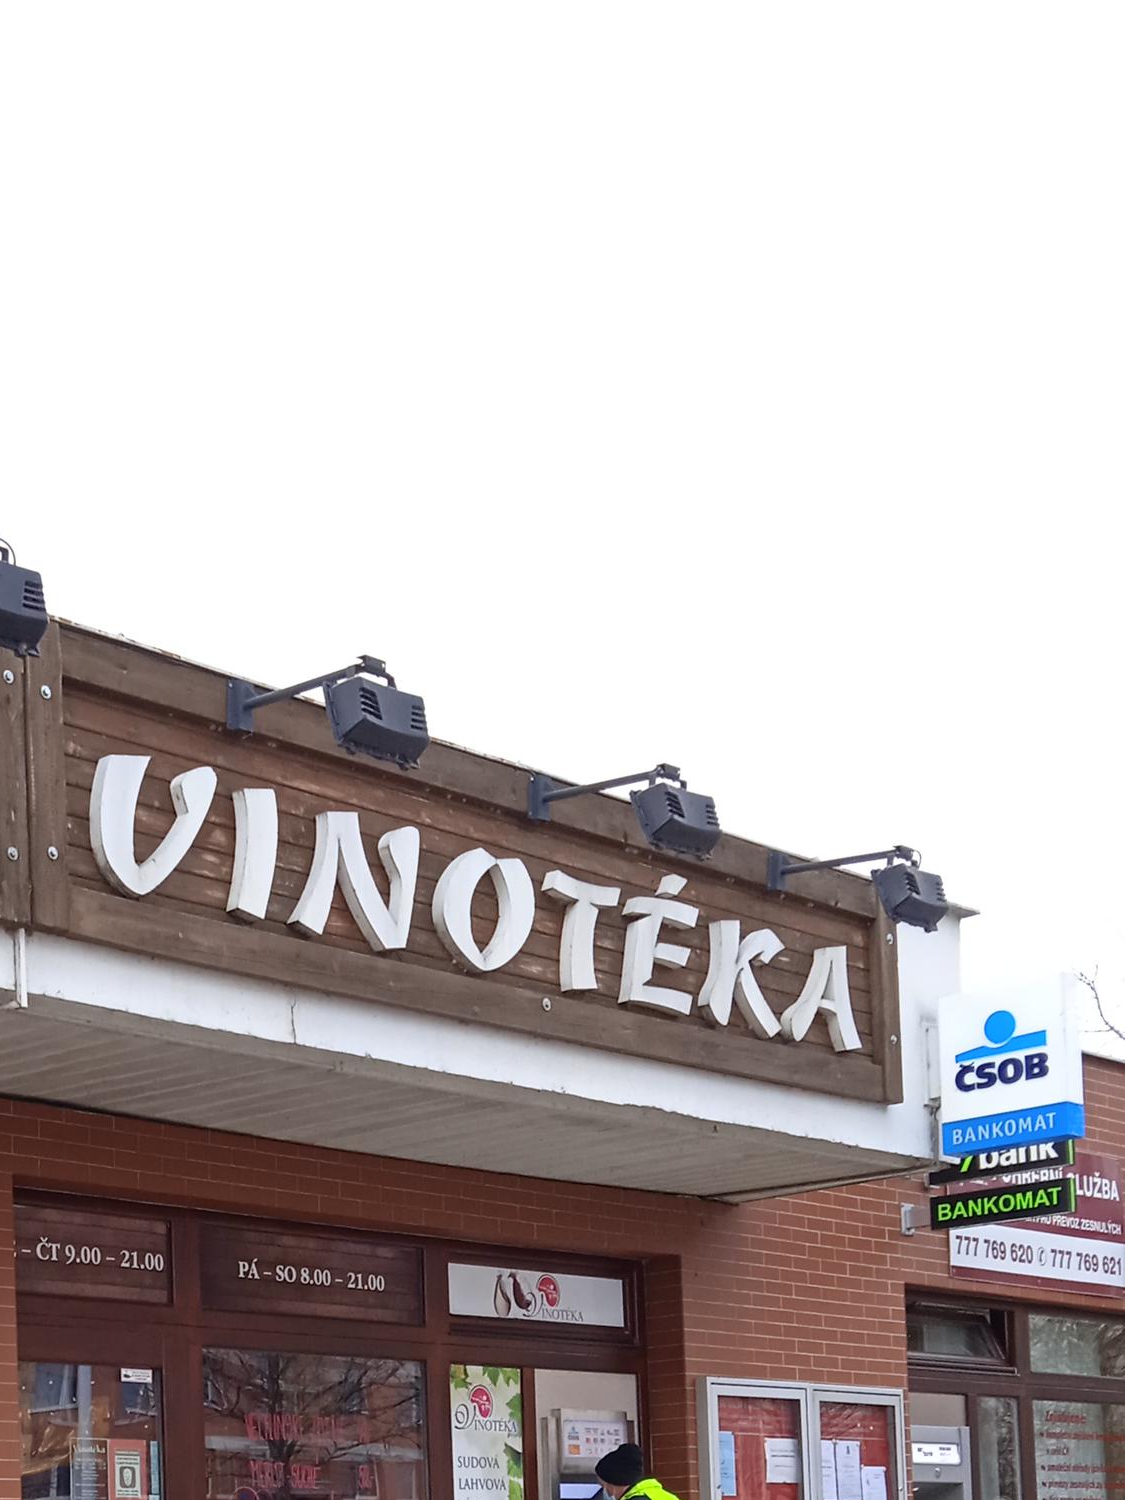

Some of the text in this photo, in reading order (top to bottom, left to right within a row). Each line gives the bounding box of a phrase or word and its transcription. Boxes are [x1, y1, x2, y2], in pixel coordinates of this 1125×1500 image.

[89, 754, 862, 1053] VINOTÉKA
[954, 1052, 1049, 1093] ČSOB
[952, 1112, 1057, 1146] BANKOMAT
[937, 1187, 1062, 1221] BANKOMAT
[35, 1237, 60, 1261] ČT
[65, 1244, 101, 1265] 9.00
[119, 1250, 164, 1271] 21.00
[956, 1235, 1122, 1275] 777 769 620 777 769 621
[238, 1258, 260, 1280] PÁ
[275, 1265, 297, 1283] SO
[300, 1267, 331, 1286] 8.00
[346, 1272, 385, 1291] 21.00
[457, 1454, 499, 1469] SUDOVÁ
[458, 1477, 507, 1491] LAHVOVÁ
